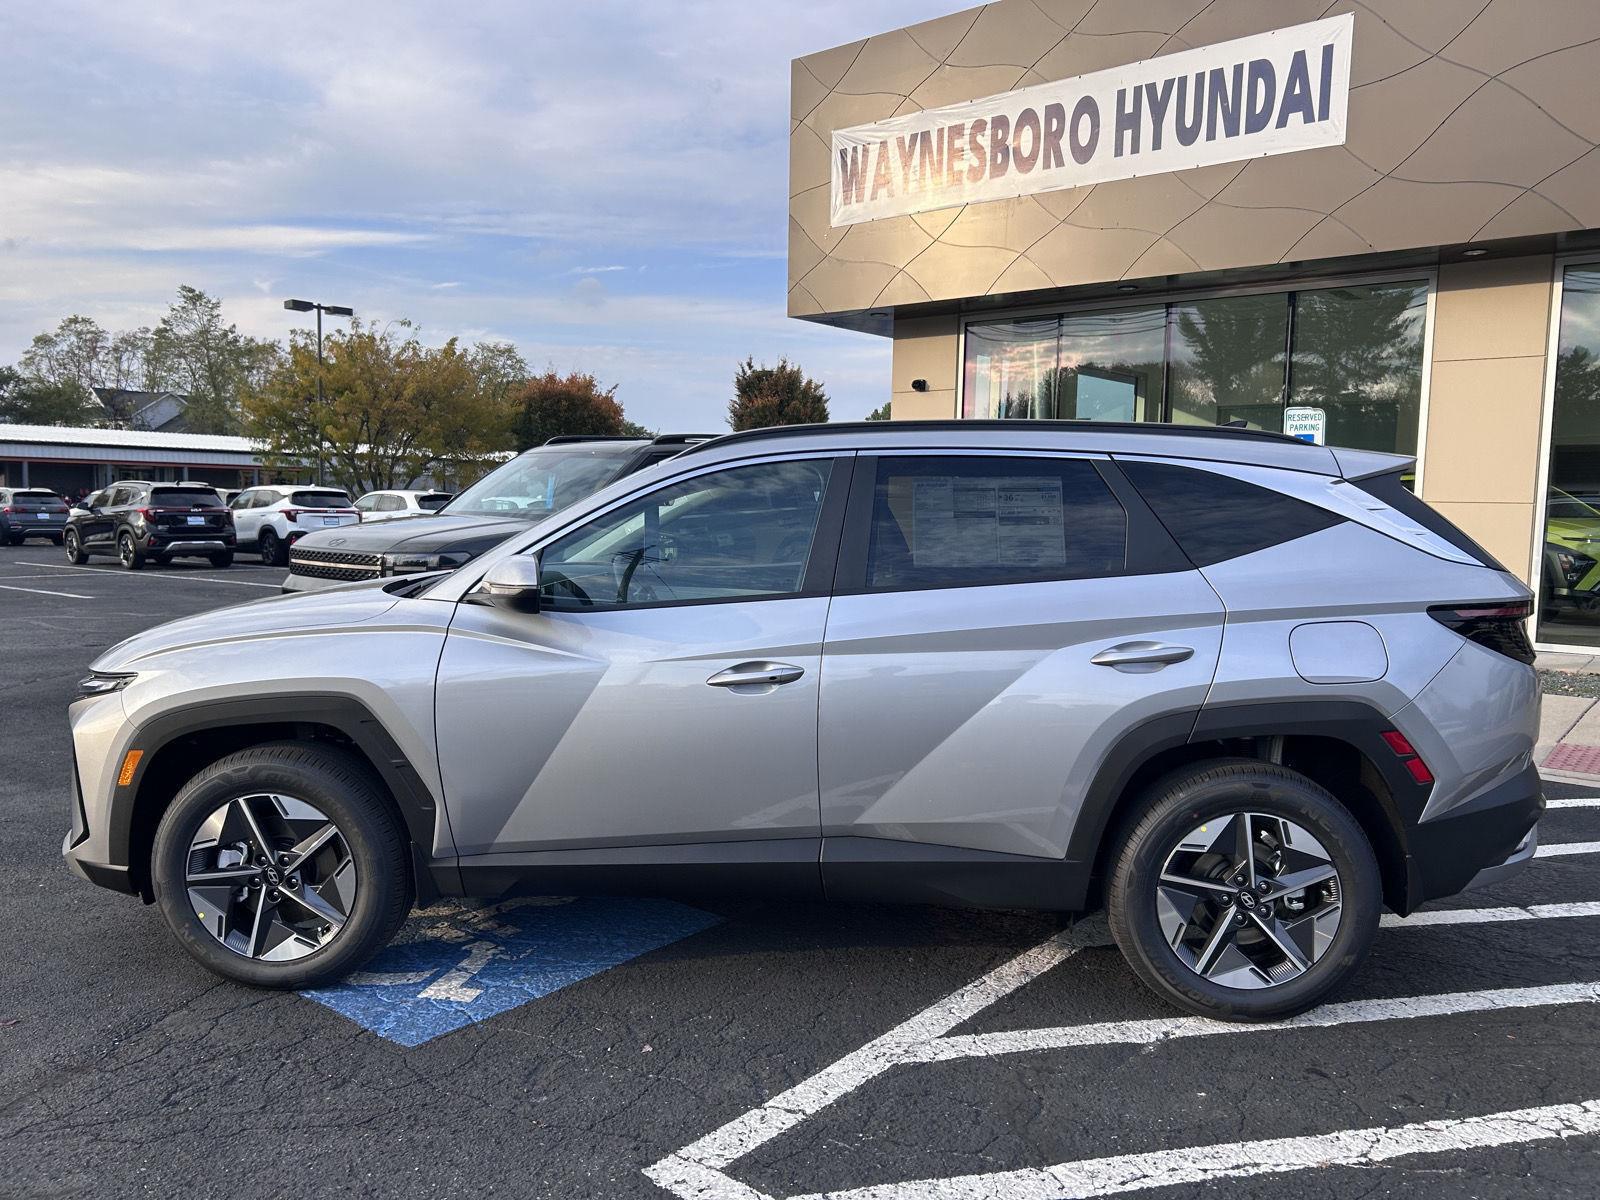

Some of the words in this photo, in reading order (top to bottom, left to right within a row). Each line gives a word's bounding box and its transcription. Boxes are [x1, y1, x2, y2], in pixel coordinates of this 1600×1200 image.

[839, 95, 1101, 206] WAYNESBORO
[1113, 43, 1334, 158] HYUNDAI
[1288, 413, 1322, 421] RESERVED
